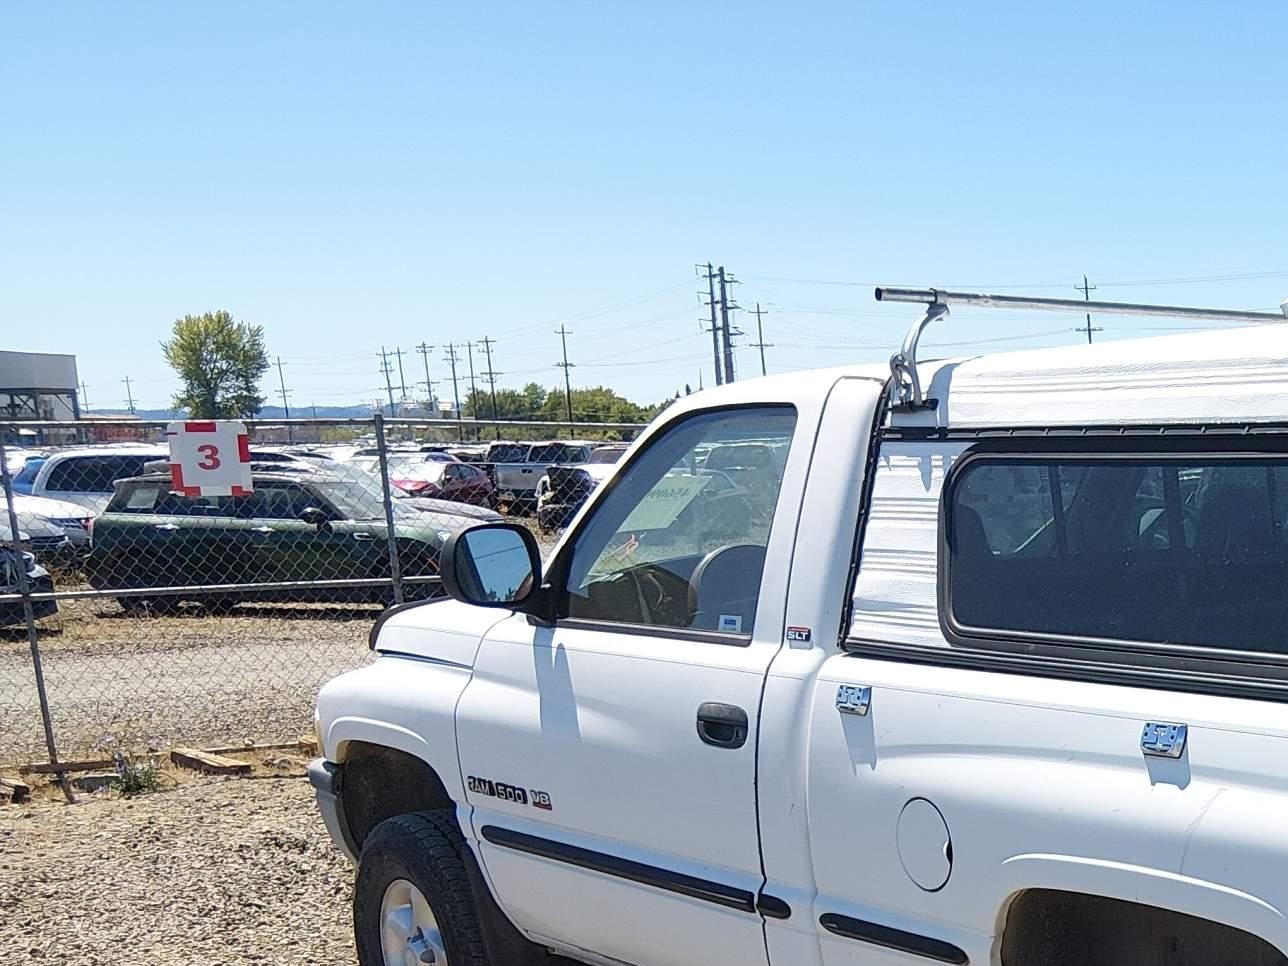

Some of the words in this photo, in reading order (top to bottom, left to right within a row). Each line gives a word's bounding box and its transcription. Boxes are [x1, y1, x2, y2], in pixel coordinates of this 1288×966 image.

[197, 444, 221, 470] 3
[788, 631, 809, 641] SLT
[467, 775, 495, 796] RAM
[530, 790, 551, 807] V8
